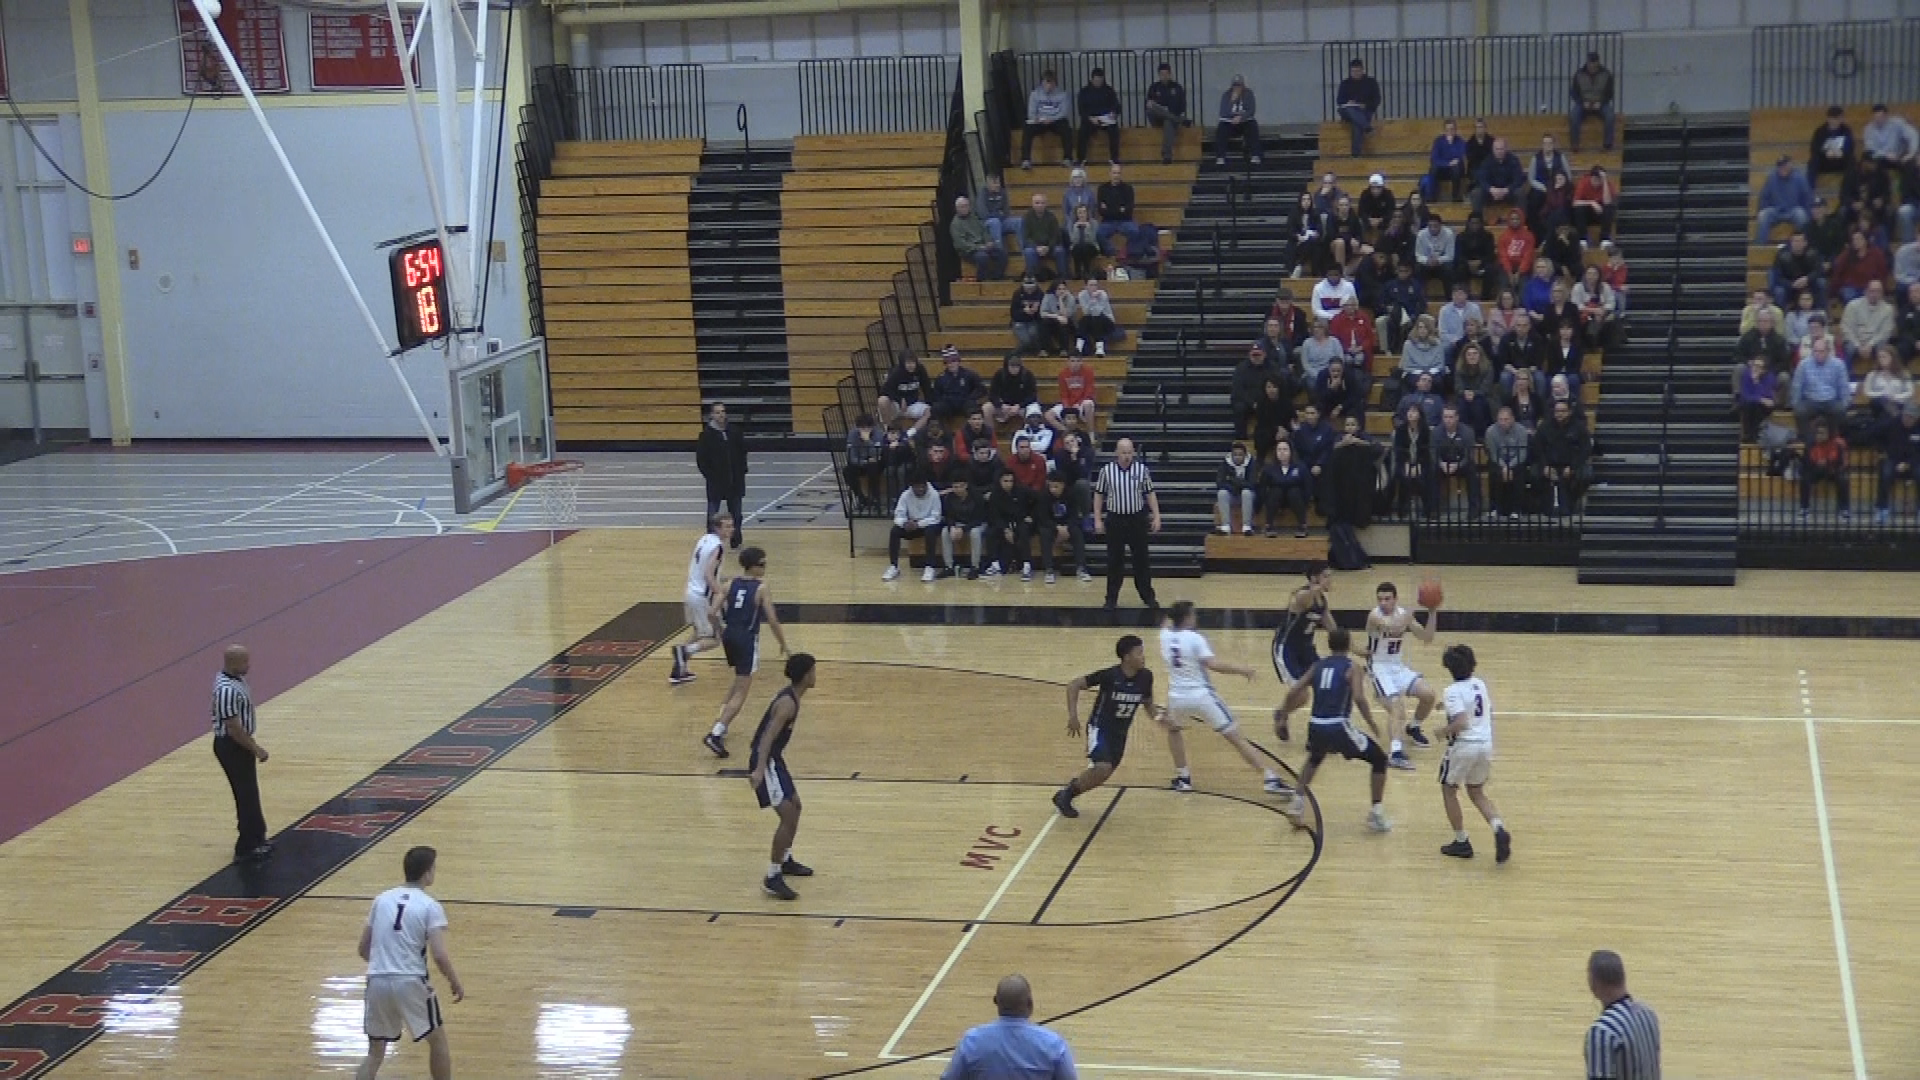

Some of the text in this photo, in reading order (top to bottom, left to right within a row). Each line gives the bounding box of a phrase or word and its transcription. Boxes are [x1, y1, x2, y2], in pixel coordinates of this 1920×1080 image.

[404, 248, 440, 287] 6:54
[734, 589, 748, 609] 5
[1320, 667, 1335, 689] 11
[1474, 693, 1484, 717] 3
[293, 639, 656, 839] ANDOVER
[959, 825, 1022, 871] MVC
[393, 903, 406, 931] 1
